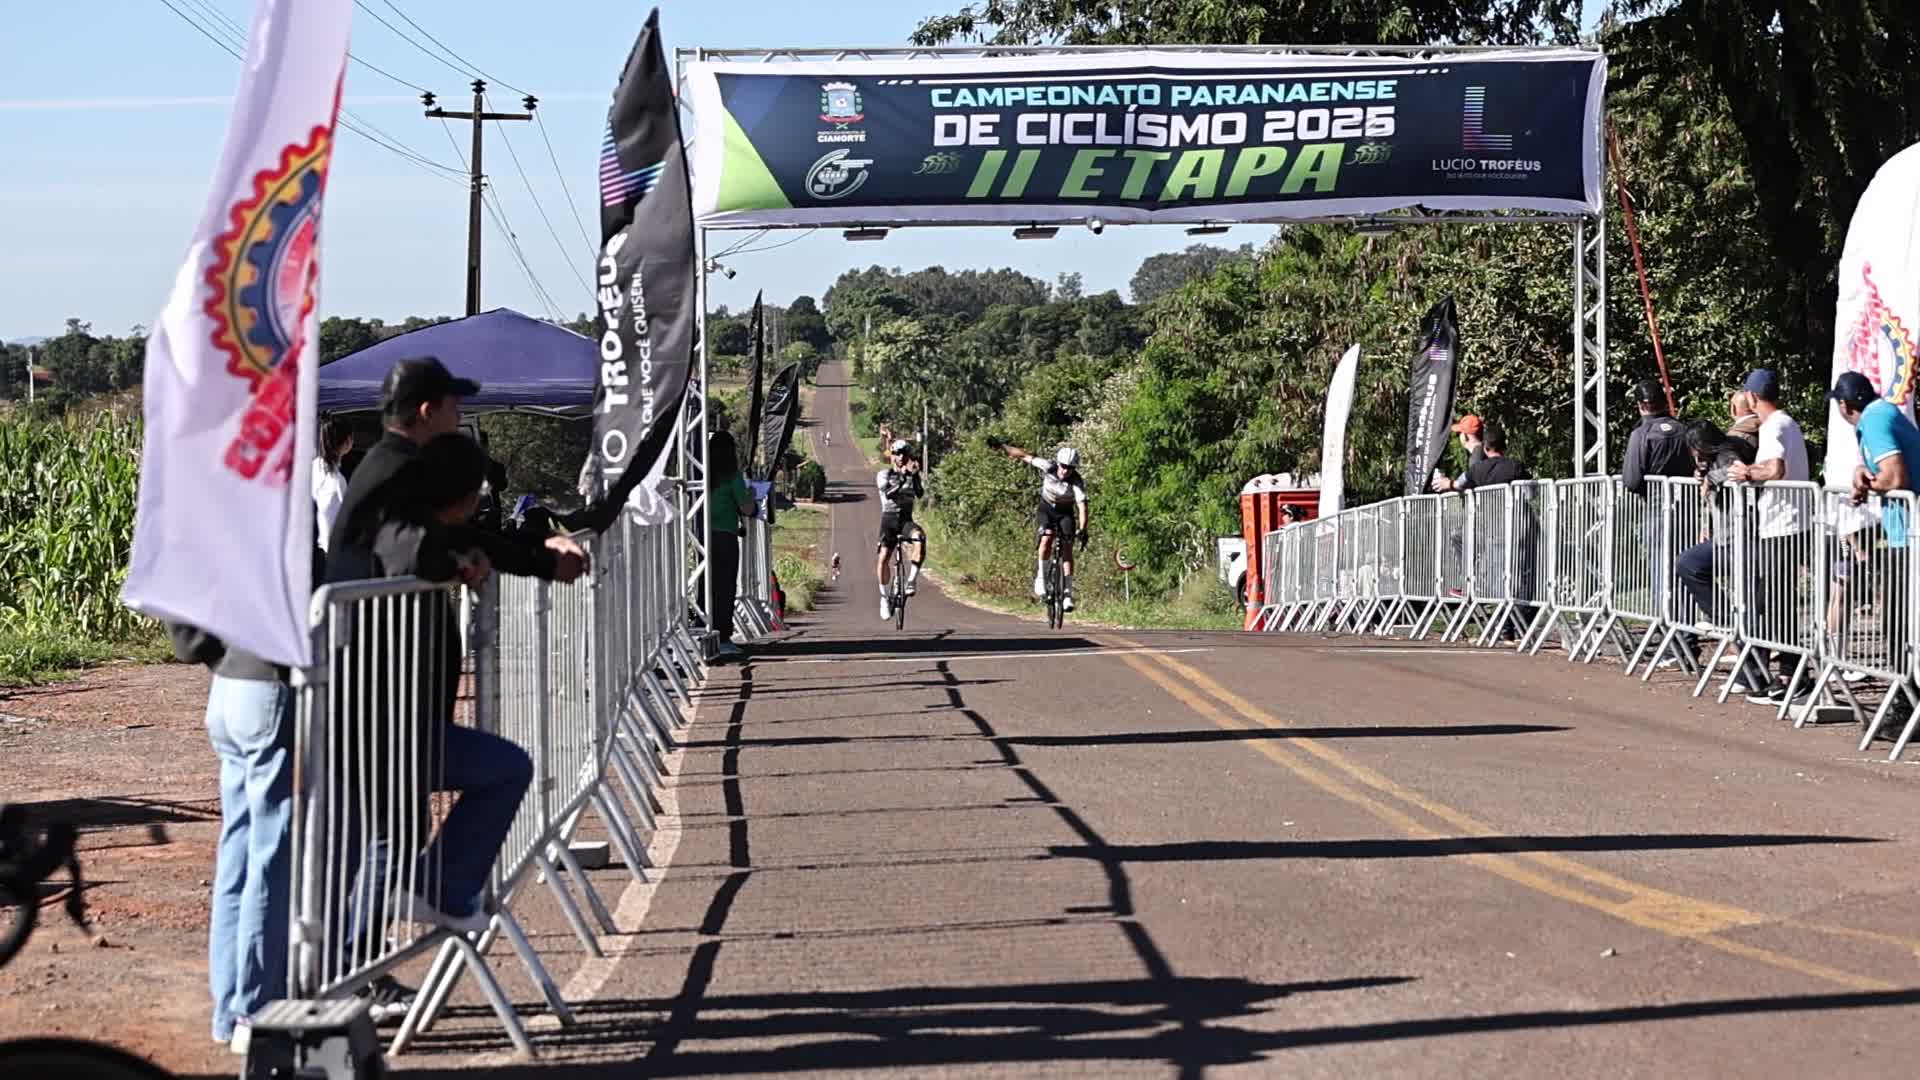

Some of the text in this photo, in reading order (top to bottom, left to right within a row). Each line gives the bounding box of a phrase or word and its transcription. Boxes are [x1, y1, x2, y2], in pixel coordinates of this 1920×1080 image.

[931, 80, 1398, 108] CAMPEONATO PARANAENSE
[817, 134, 866, 143] CIANORTE
[933, 104, 1396, 147] DE CICLÍSMO 2025
[965, 143, 1345, 202] II ETAPA
[1432, 157, 1542, 172] LUCIO TROFÉUS
[635, 338, 651, 386] VOCÊ
[641, 388, 654, 428] QUE
